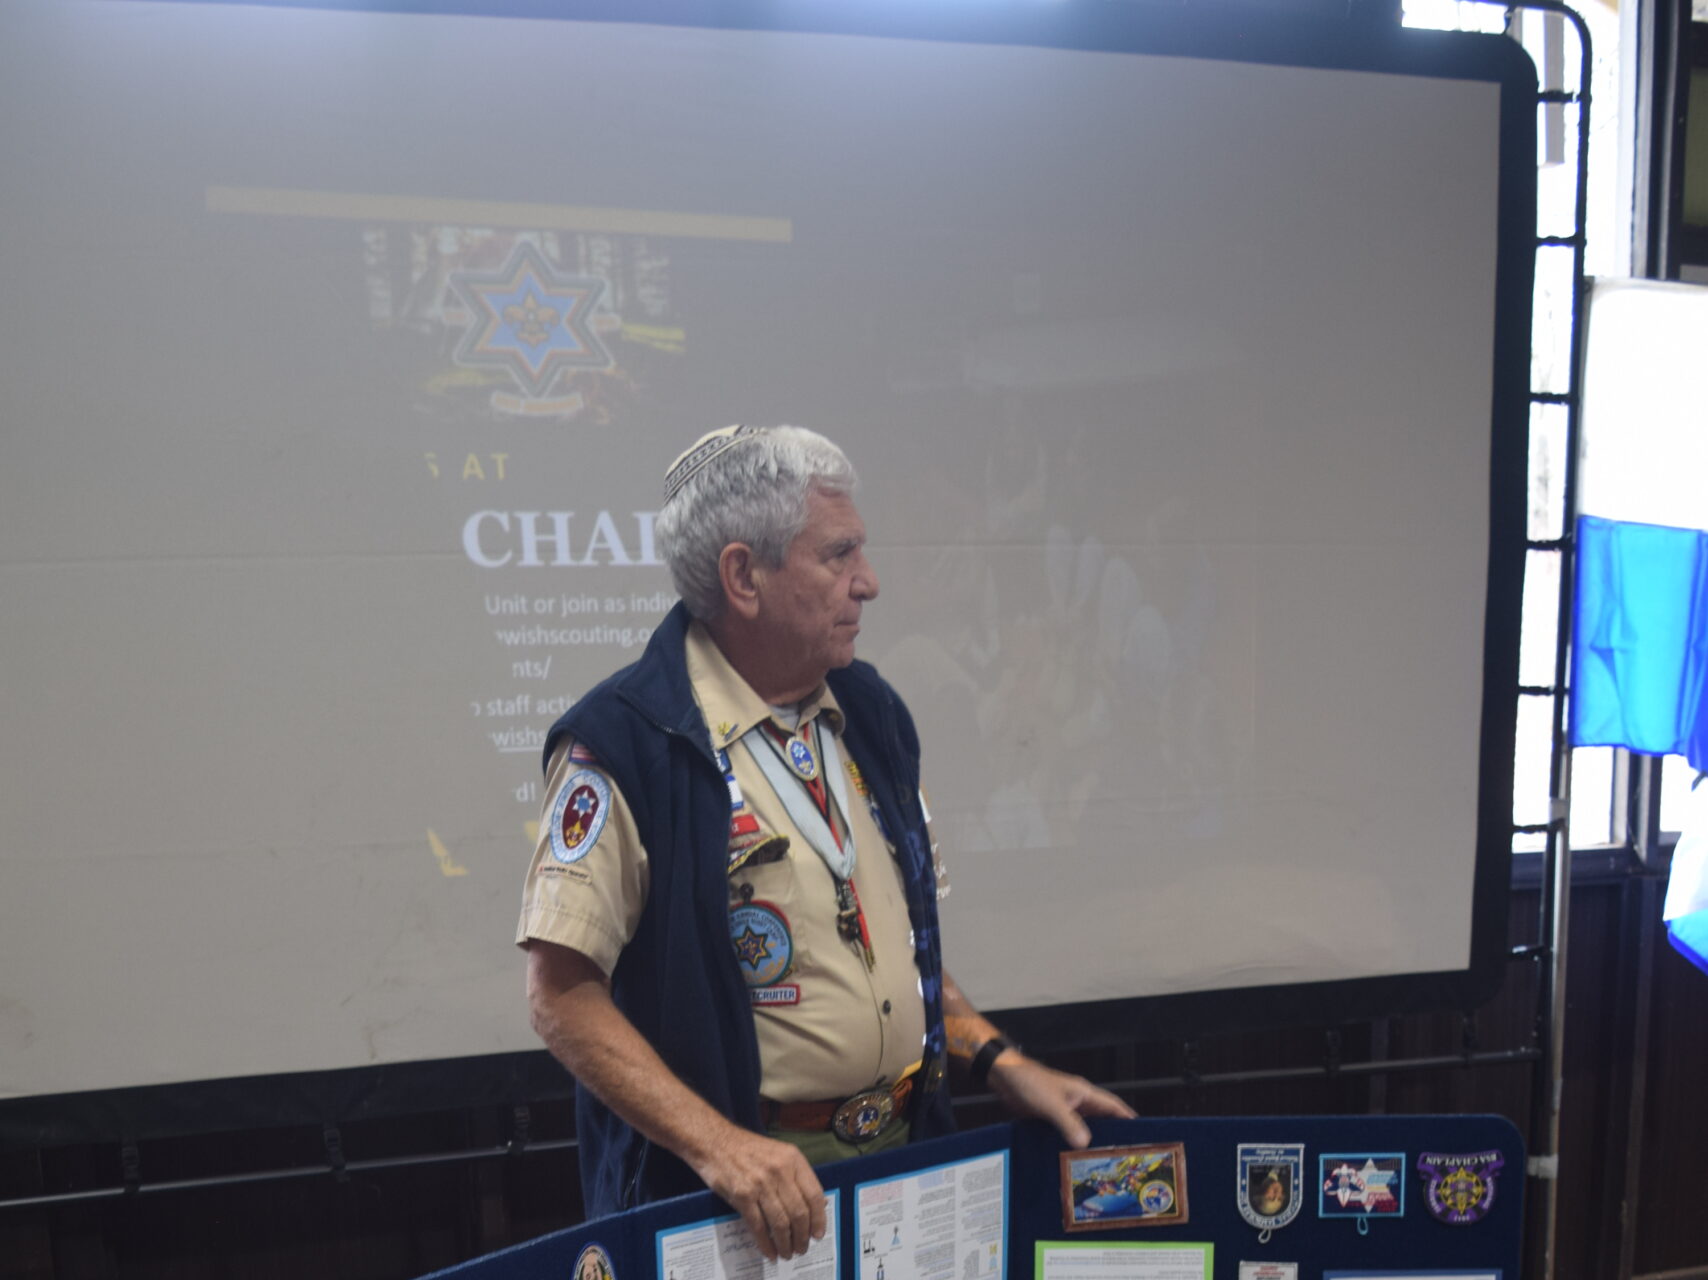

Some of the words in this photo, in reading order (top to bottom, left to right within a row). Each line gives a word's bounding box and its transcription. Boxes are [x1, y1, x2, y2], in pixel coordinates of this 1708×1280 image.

[485, 595, 529, 616] Unit
[534, 599, 554, 614] or
[561, 594, 599, 618] join
[603, 597, 626, 613] as
[486, 694, 531, 717] staff
[1426, 1156, 1478, 1169] CHAPLAIN
